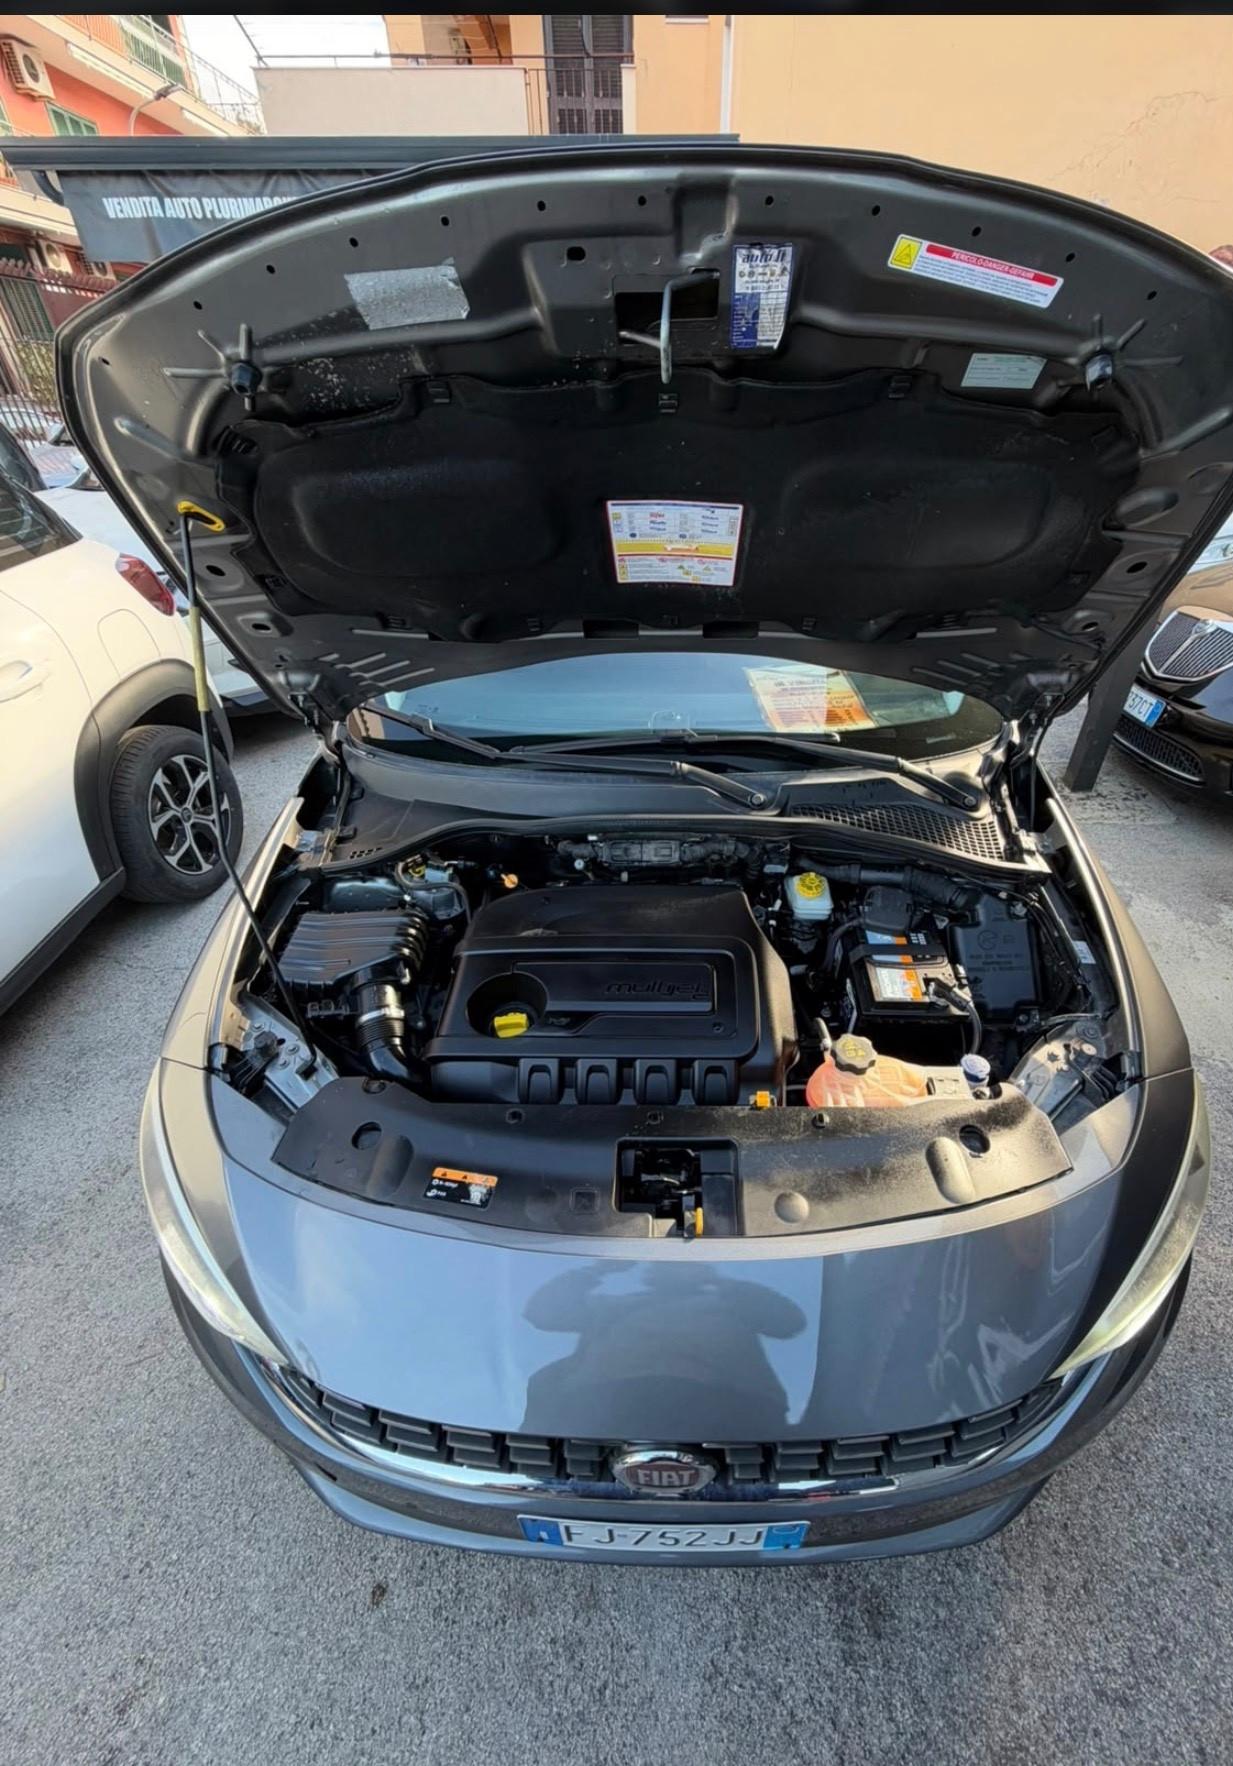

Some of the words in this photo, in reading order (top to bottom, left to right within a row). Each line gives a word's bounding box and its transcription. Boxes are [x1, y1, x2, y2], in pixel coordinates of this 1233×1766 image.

[102, 197, 164, 219] VENDITA
[163, 197, 204, 219] AUTO
[637, 1468, 696, 1488] FIAT
